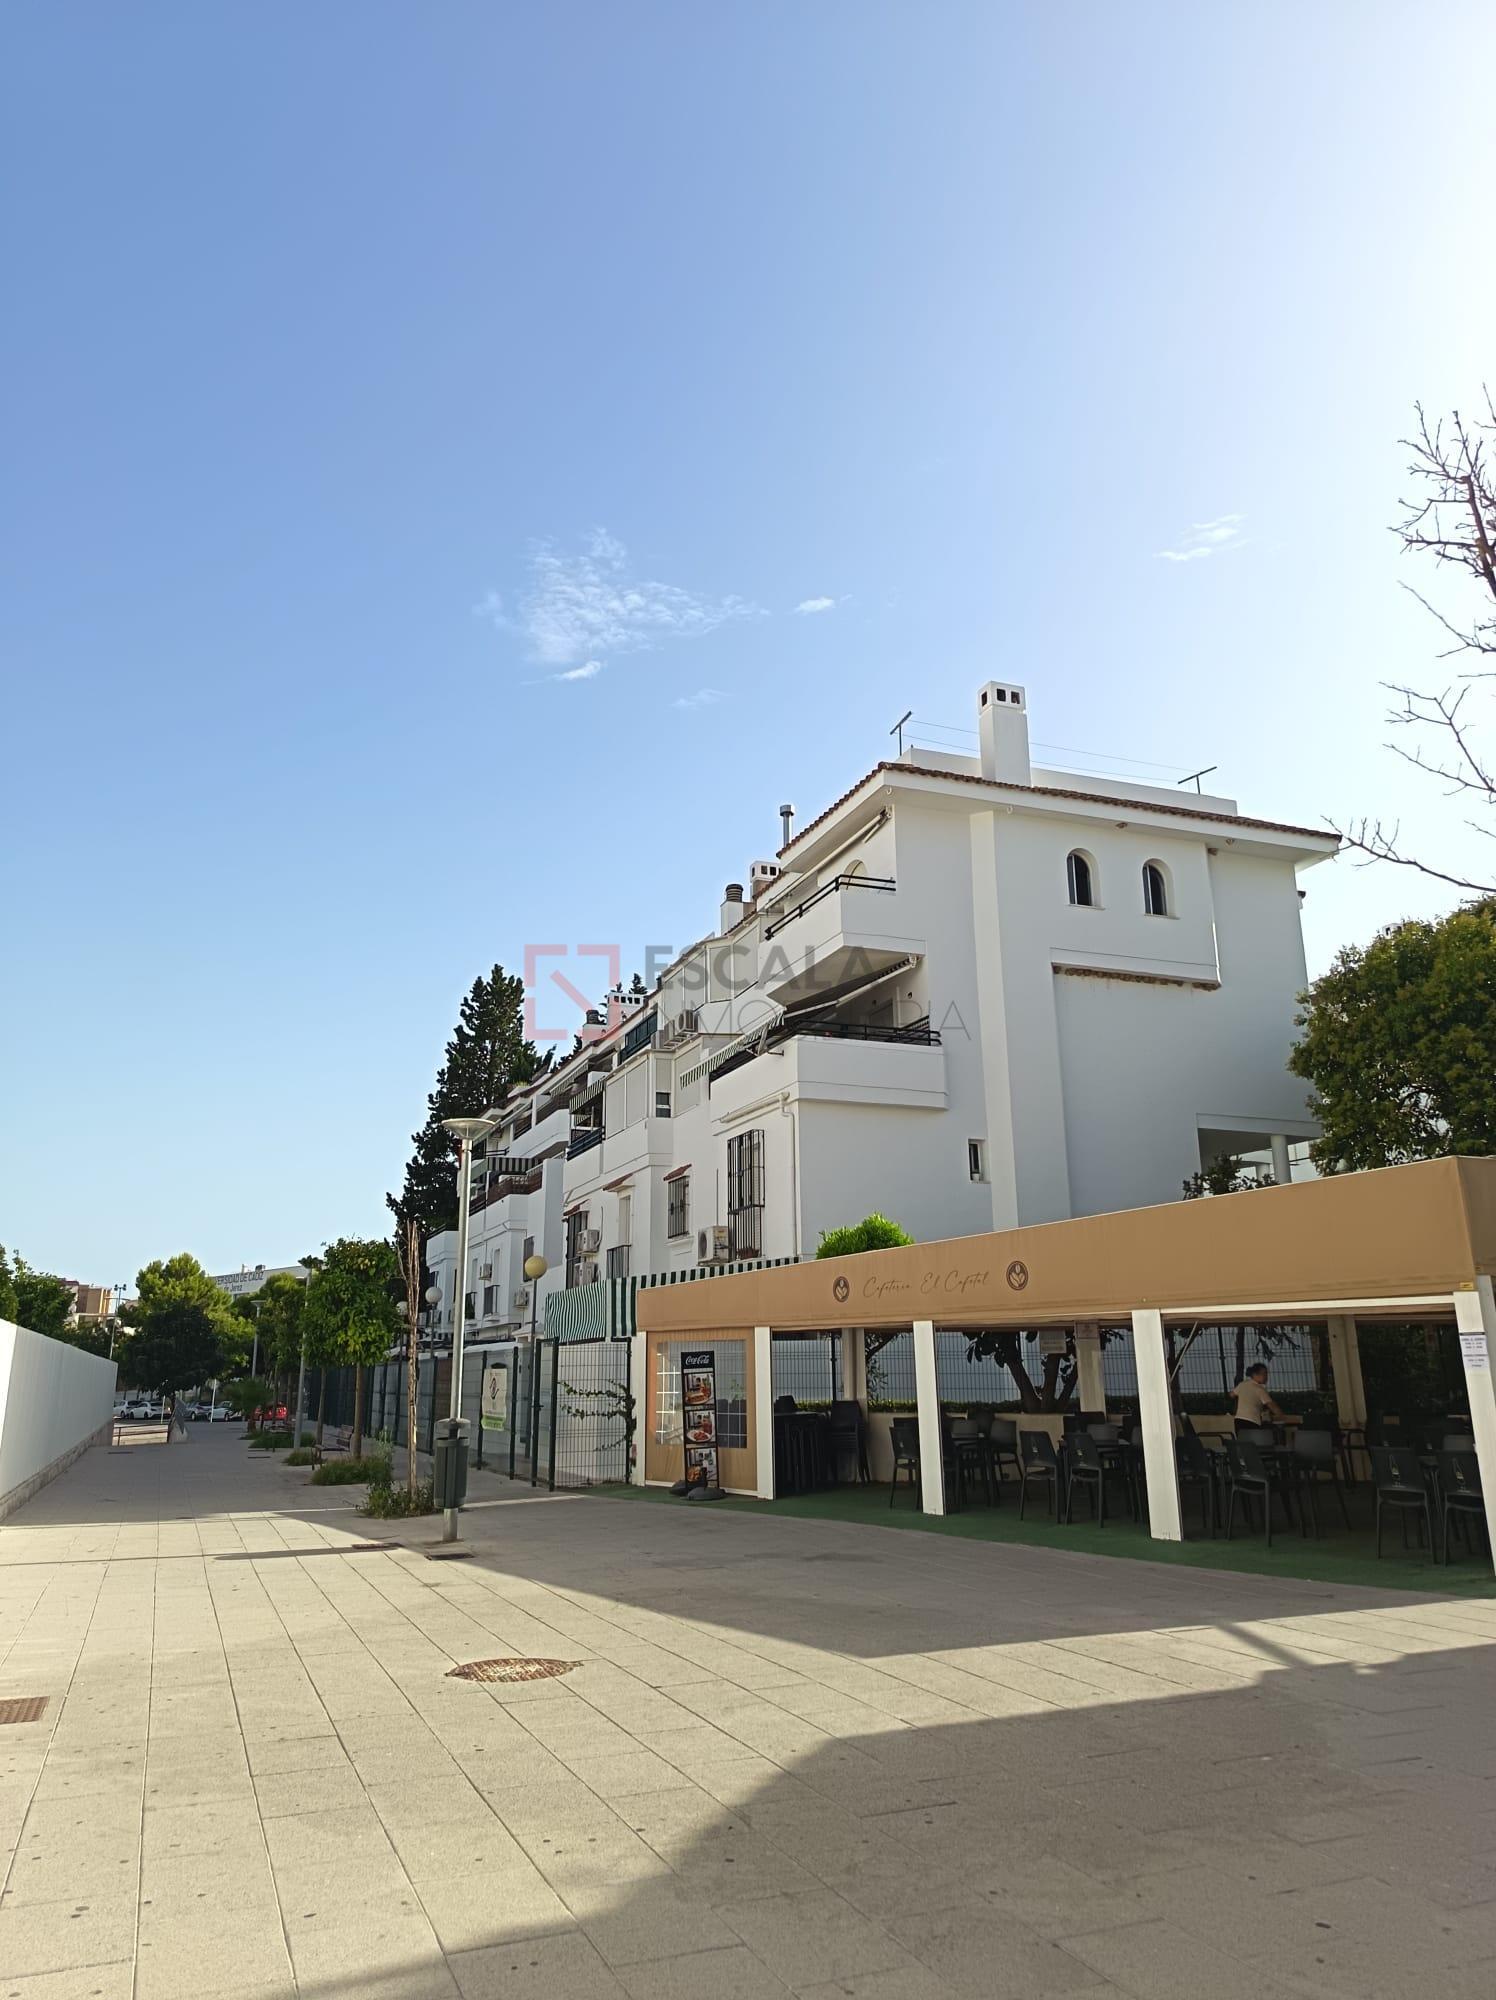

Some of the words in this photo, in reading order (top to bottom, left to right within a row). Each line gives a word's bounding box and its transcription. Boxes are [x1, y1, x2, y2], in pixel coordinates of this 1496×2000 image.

[240, 1272, 248, 1282] DE
[230, 1284, 243, 1292] Jerez
[920, 1271, 940, 1295] El
